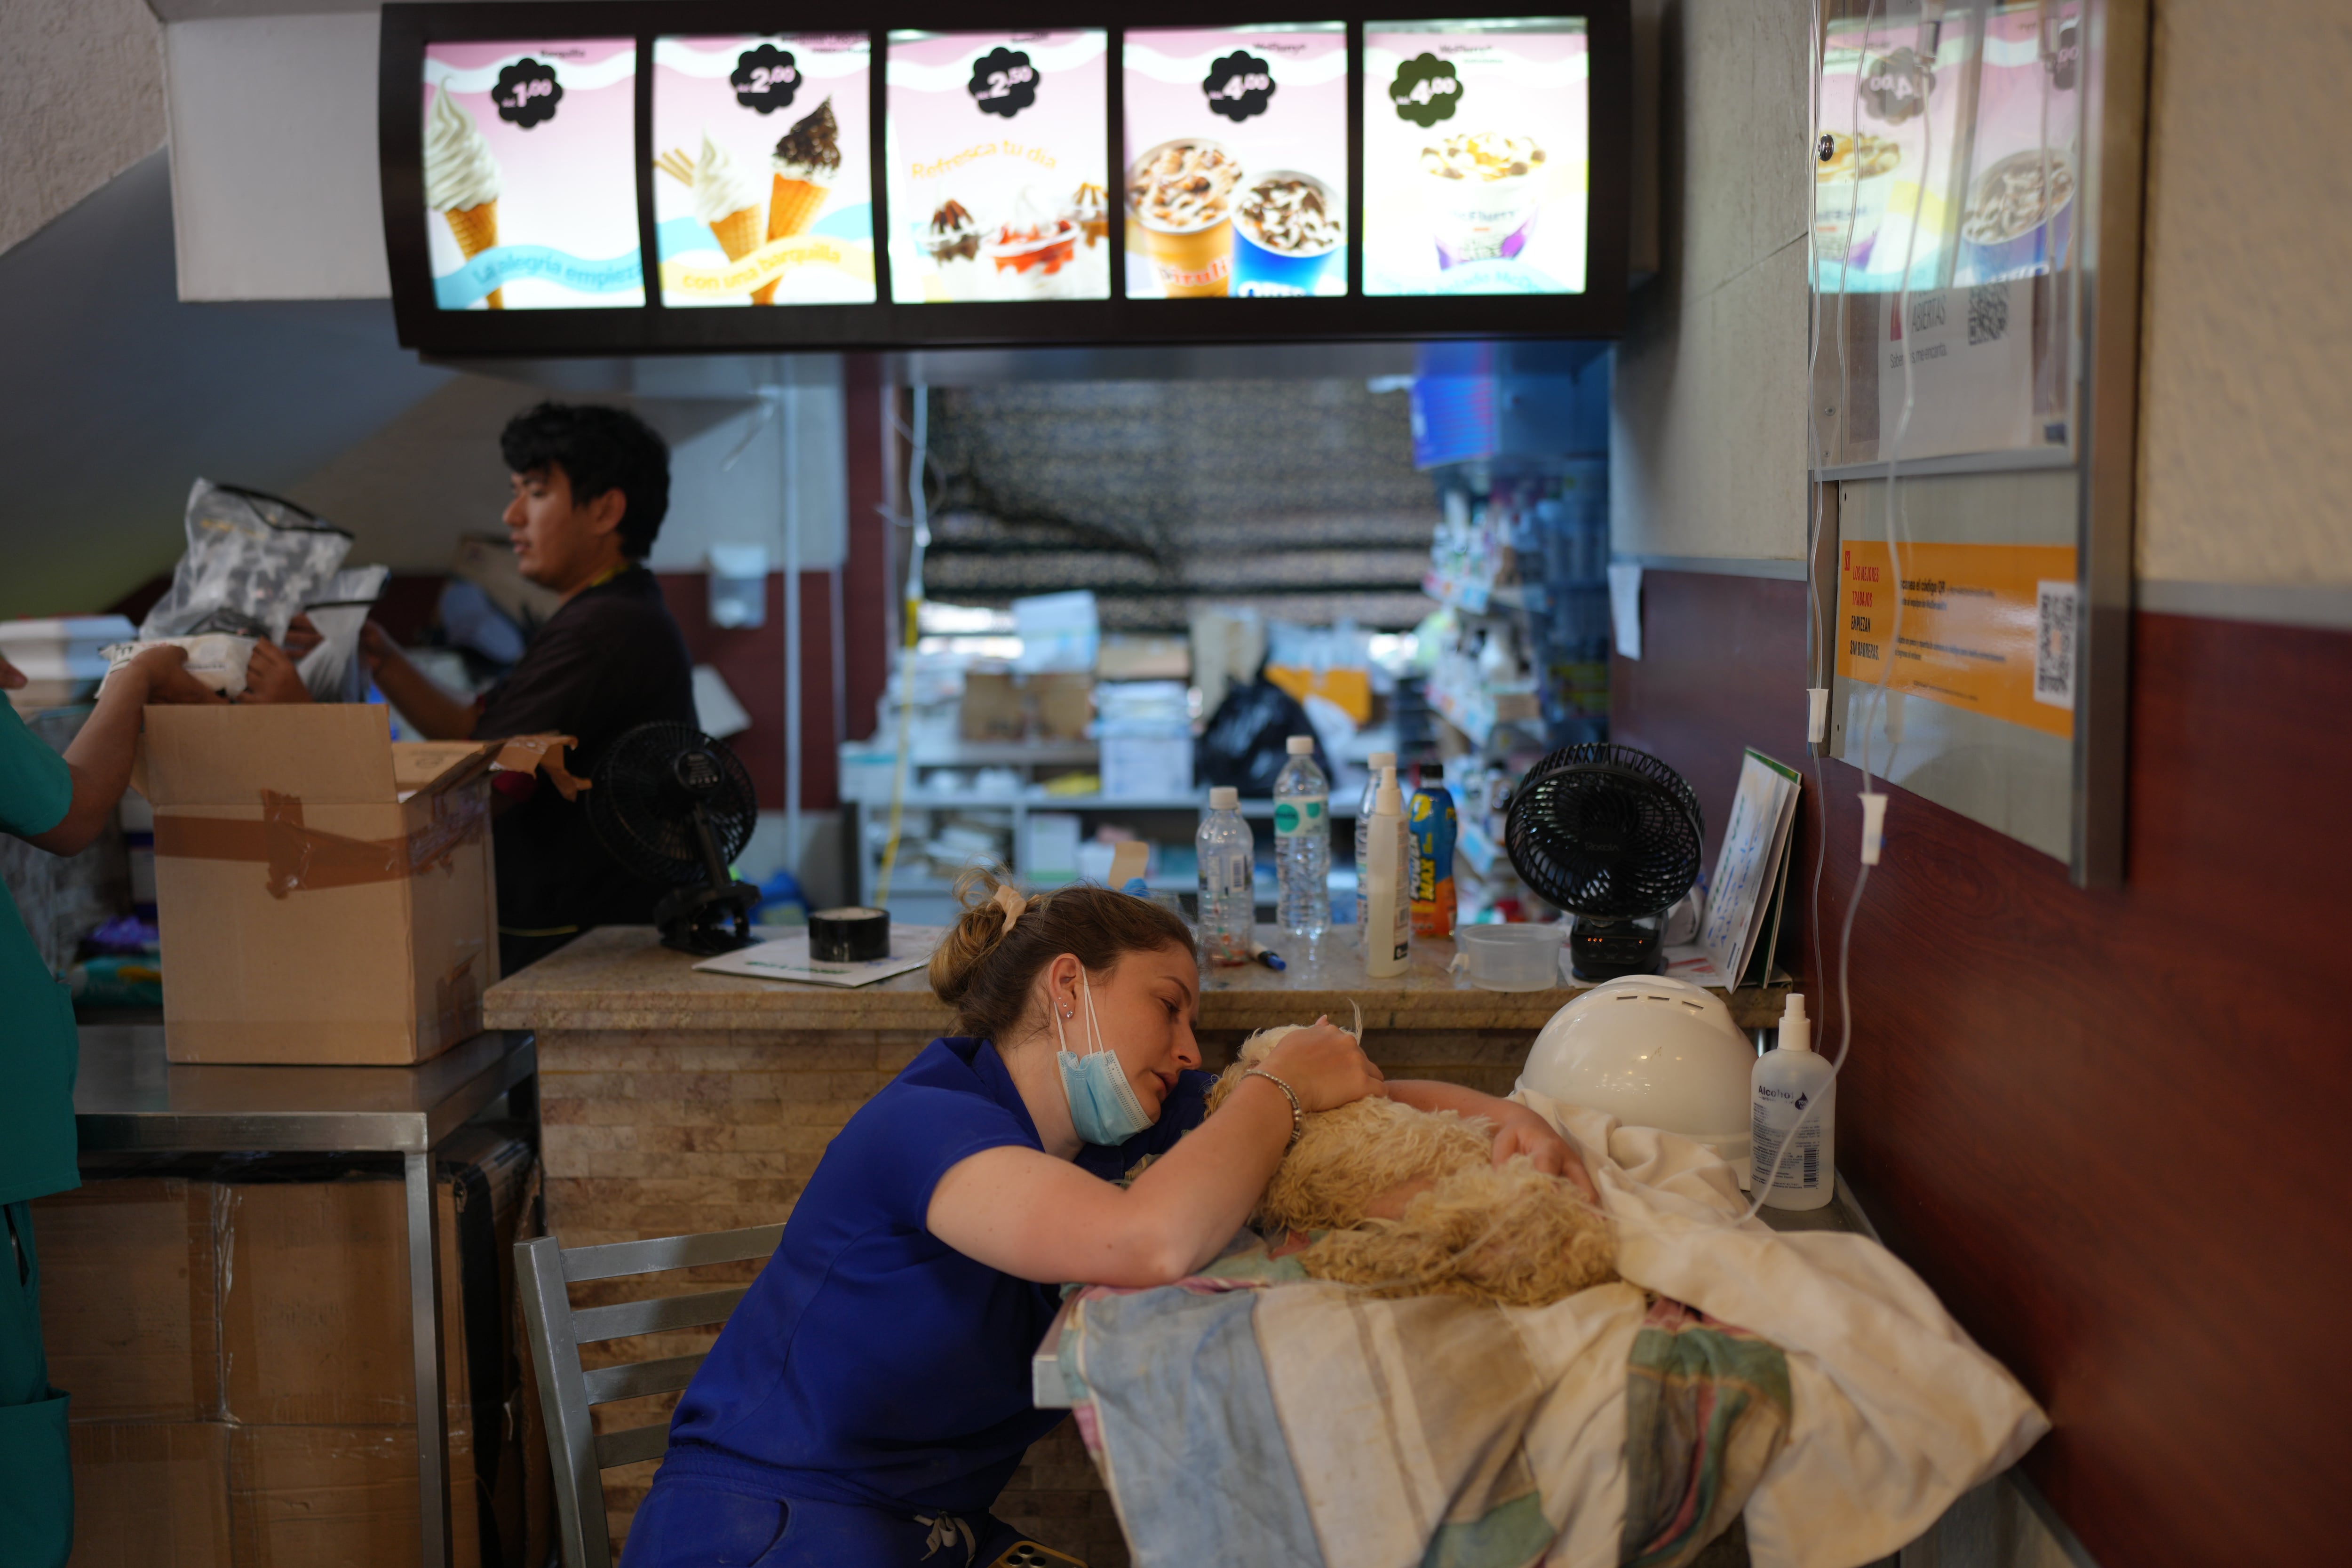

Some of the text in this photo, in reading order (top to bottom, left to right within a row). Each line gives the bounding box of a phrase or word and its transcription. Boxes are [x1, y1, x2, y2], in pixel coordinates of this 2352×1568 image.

[911, 142, 997, 181] Refresca
[1003, 139, 1024, 157] tu
[472, 263, 497, 286] La
[683, 243, 841, 290] con una barquilla
[1861, 567, 1879, 582] MEJORES
[1852, 590, 1873, 608] TRABAJOS
[1851, 615, 1871, 633] EMPIEZAN
[1858, 641, 1880, 661] BARRERAS.
[1419, 858, 1435, 900] MAX
